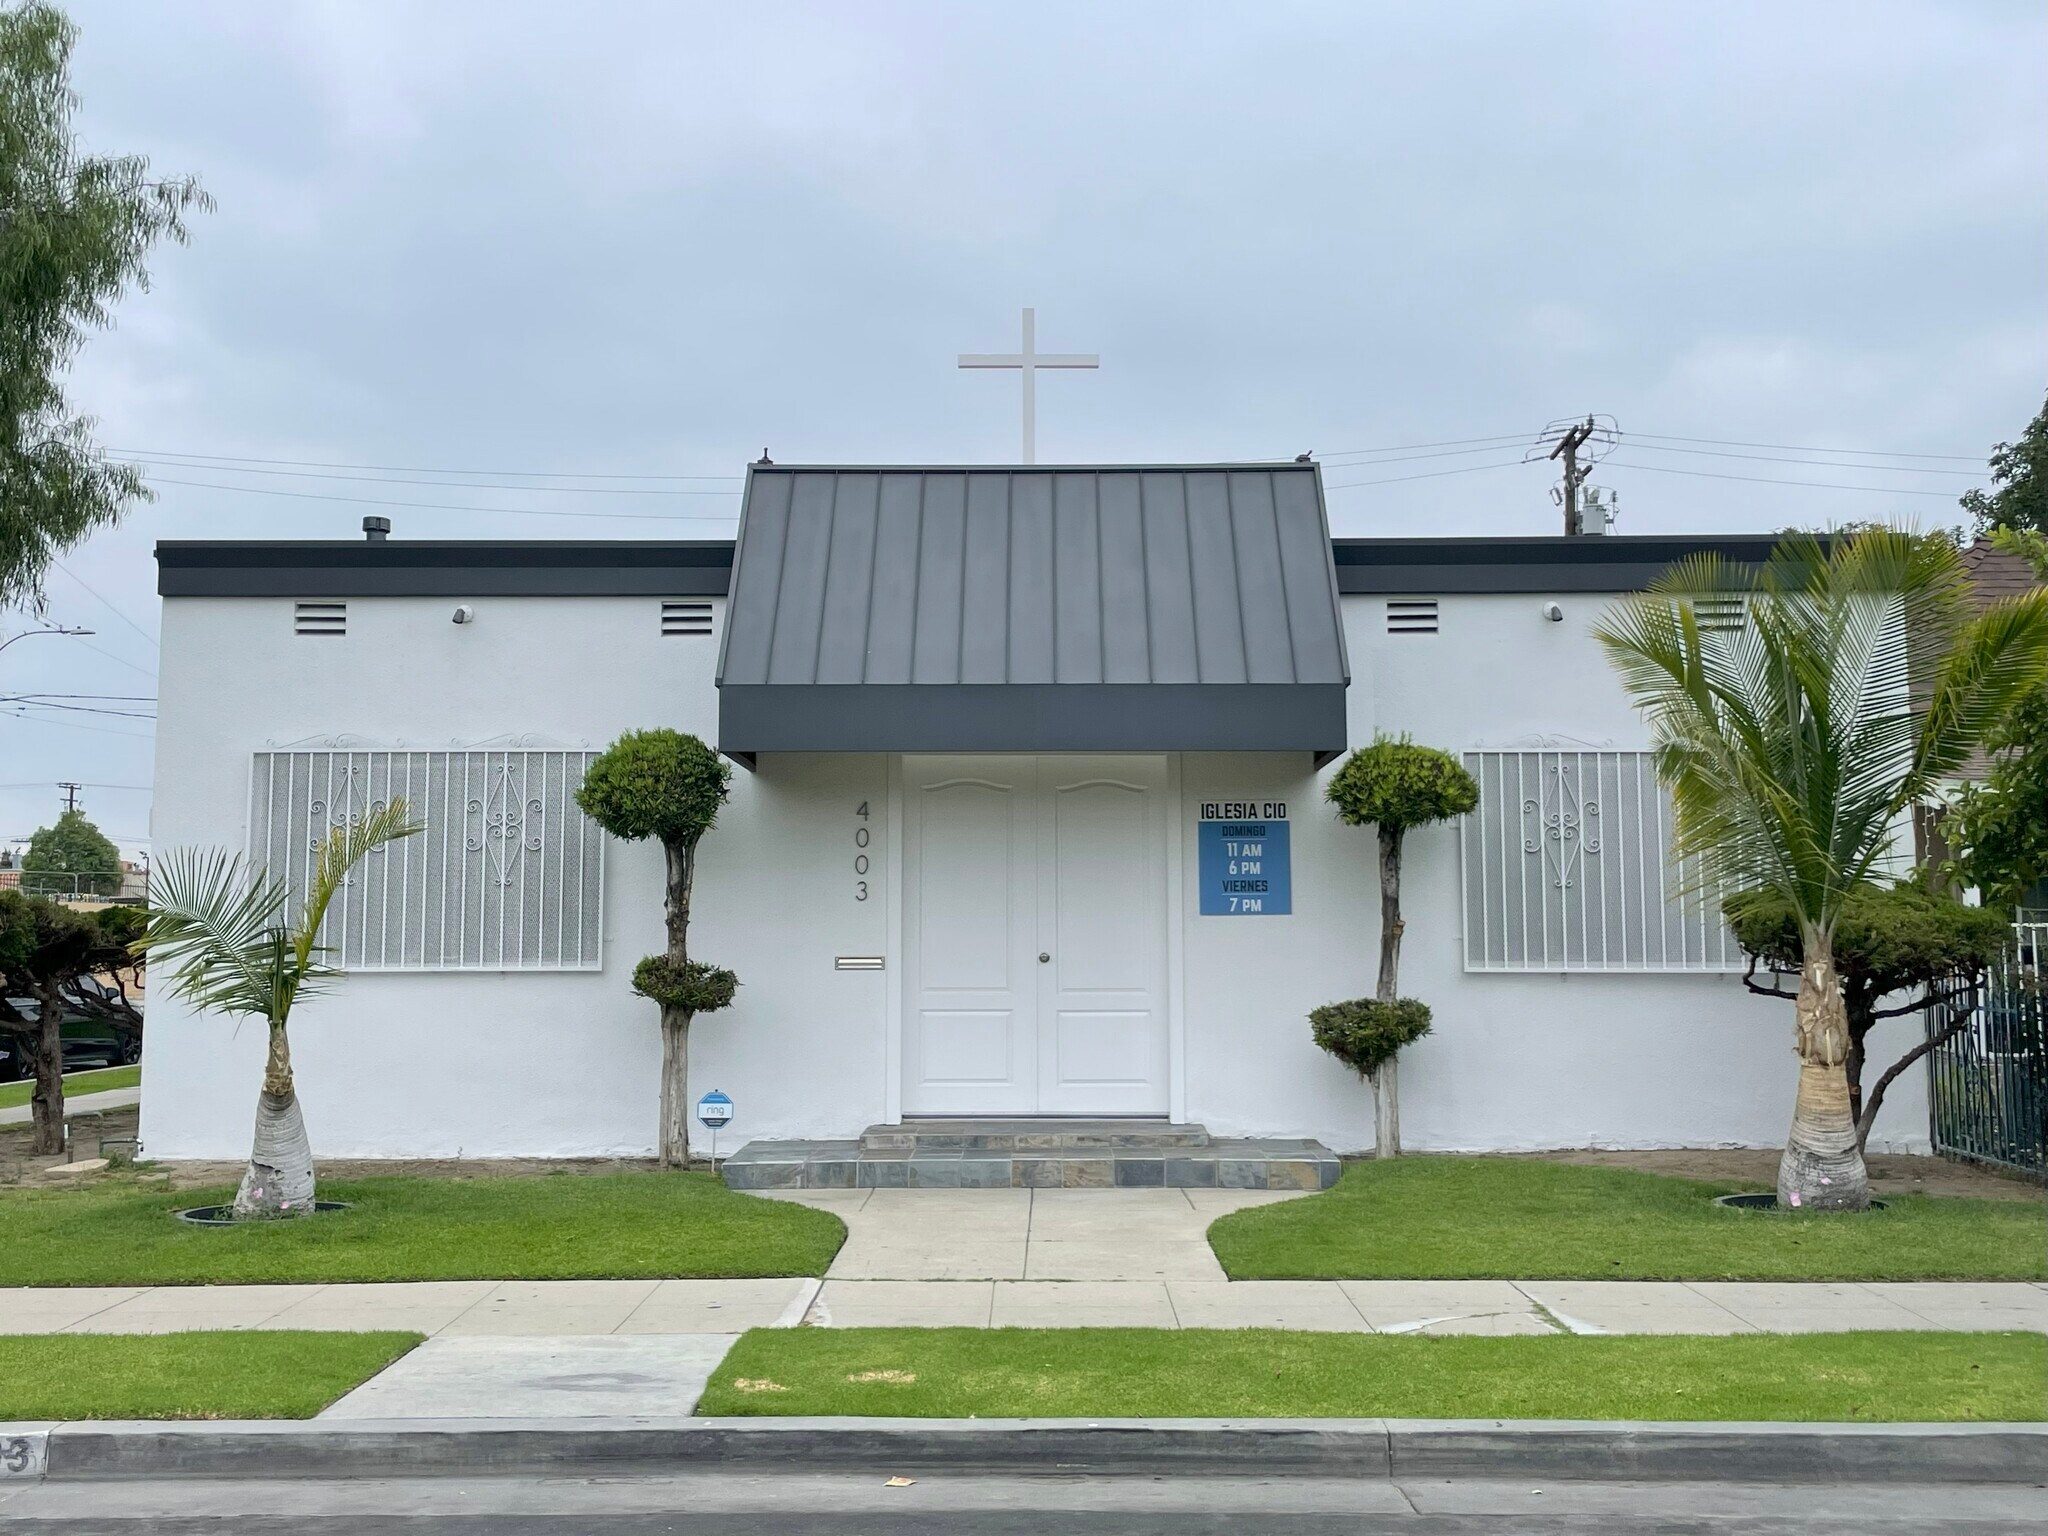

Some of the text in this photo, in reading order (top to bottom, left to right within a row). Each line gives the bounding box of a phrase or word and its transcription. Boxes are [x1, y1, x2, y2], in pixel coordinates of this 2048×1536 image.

[1201, 803, 1258, 819] IGLESIA
[1222, 825, 1266, 837] DOMINGO
[855, 801, 870, 901] 4003
[1227, 842, 1262, 857] 11 AM
[1229, 860, 1261, 875] 6 PM
[1222, 880, 1269, 892] VIERNES
[1230, 897, 1262, 912] 7 PM
[706, 1104, 725, 1117] ring
[0, 1438, 30, 1473] 3
